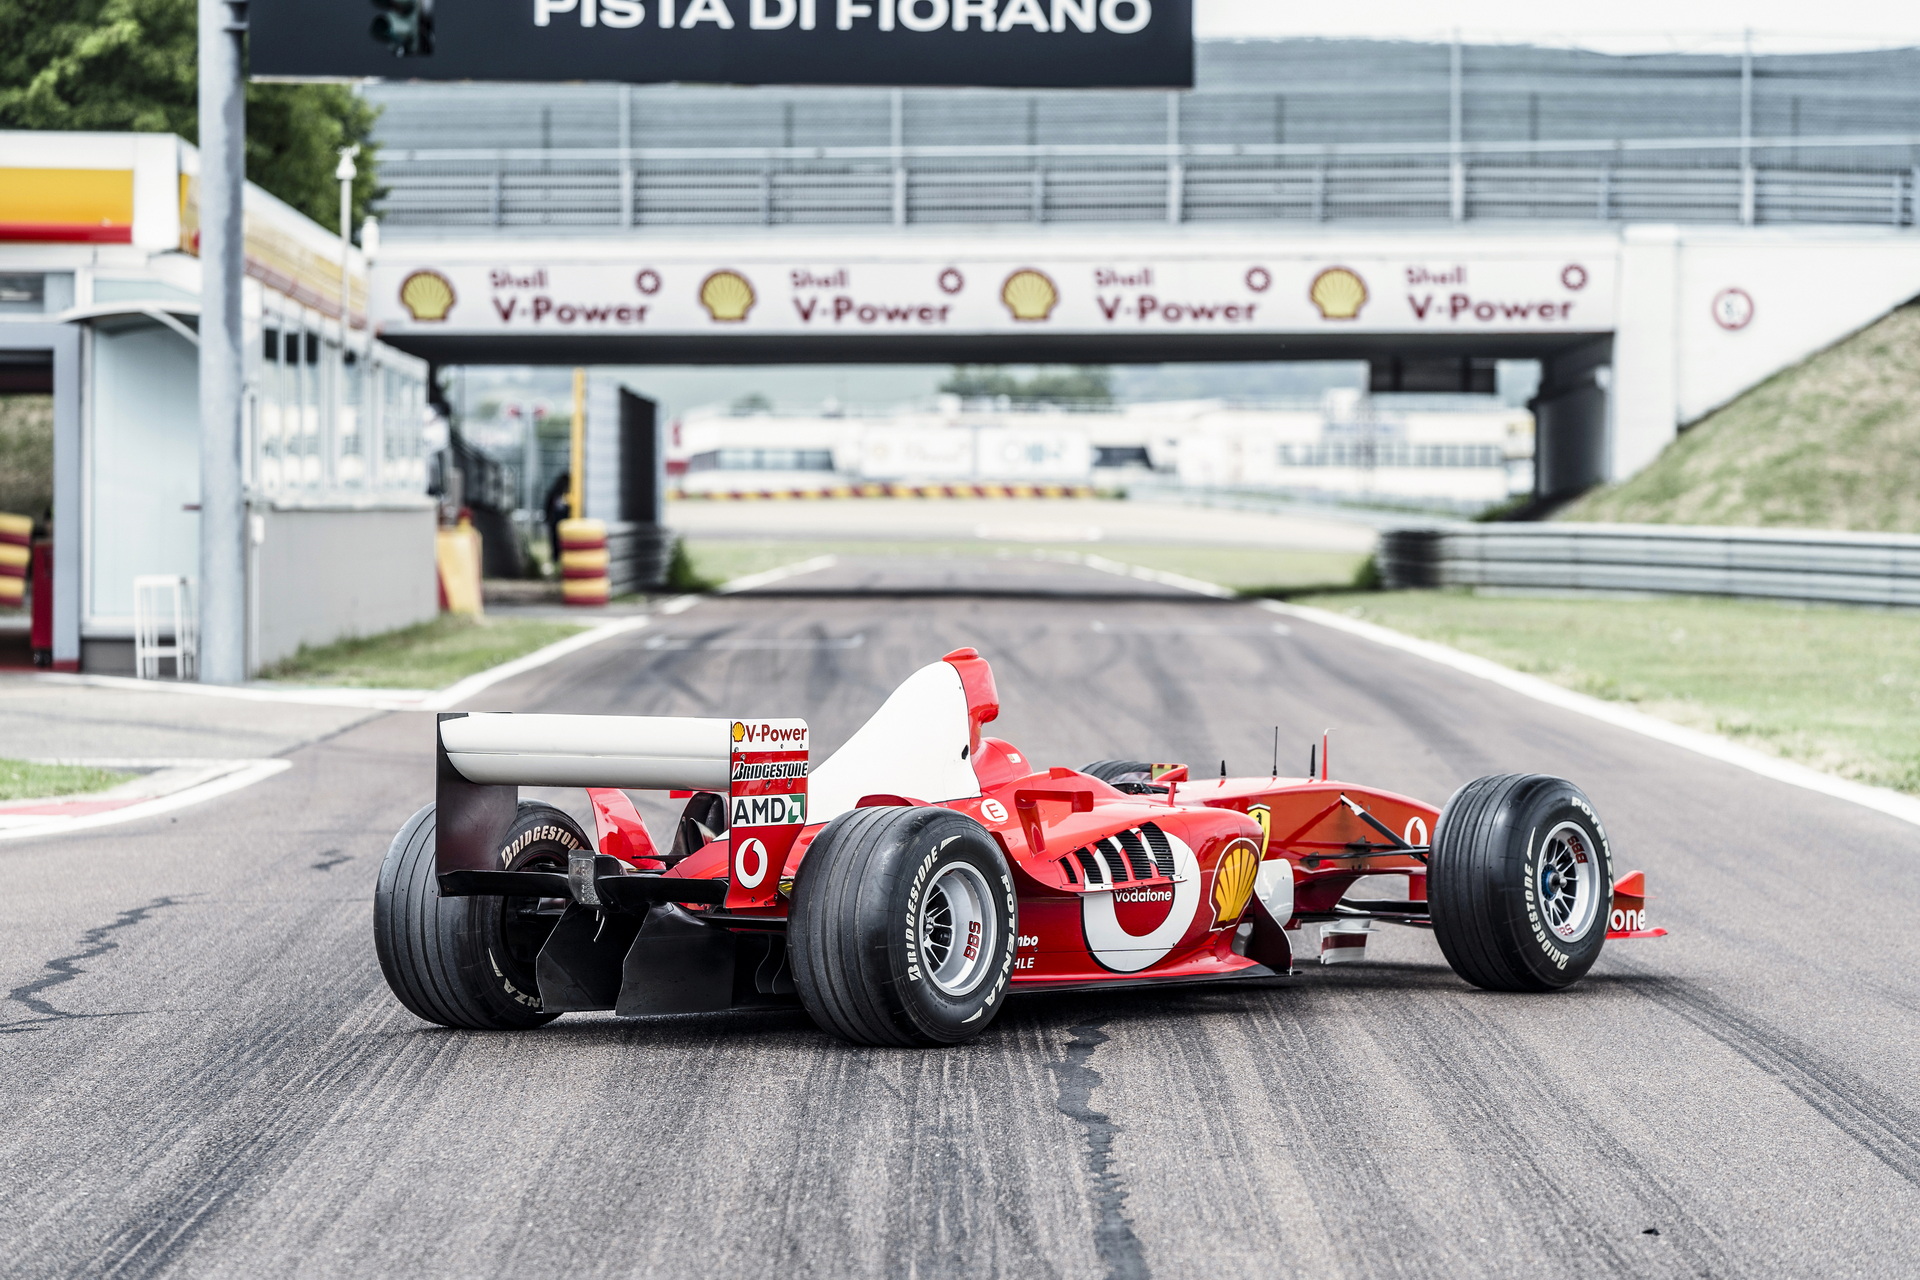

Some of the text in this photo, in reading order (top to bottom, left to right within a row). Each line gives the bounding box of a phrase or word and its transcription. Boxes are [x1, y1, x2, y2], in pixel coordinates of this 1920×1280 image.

[533, 0, 1152, 34] PISTA DI FIORANO
[490, 268, 546, 289] Shell
[791, 268, 847, 288] Shell
[1095, 267, 1152, 287] Shell
[1406, 266, 1466, 285] Shell
[491, 297, 650, 325] V-Power
[792, 297, 953, 324] V-Power
[1097, 295, 1257, 322] V-Power
[1407, 293, 1573, 321] V-Power
[745, 724, 807, 742] V-Power
[733, 761, 808, 781] BRIDGESTONE
[732, 797, 786, 825] AMD
[501, 825, 585, 870] BRIDGESTON
[1567, 835, 1588, 864] BBS
[1115, 888, 1172, 903] vodafone
[904, 845, 938, 982] BRIDGESTONE
[1524, 862, 1570, 971] BRIDGESTONE
[1610, 909, 1646, 931] one
[963, 921, 981, 961] BBS
[984, 874, 1015, 1007] POTENZA
